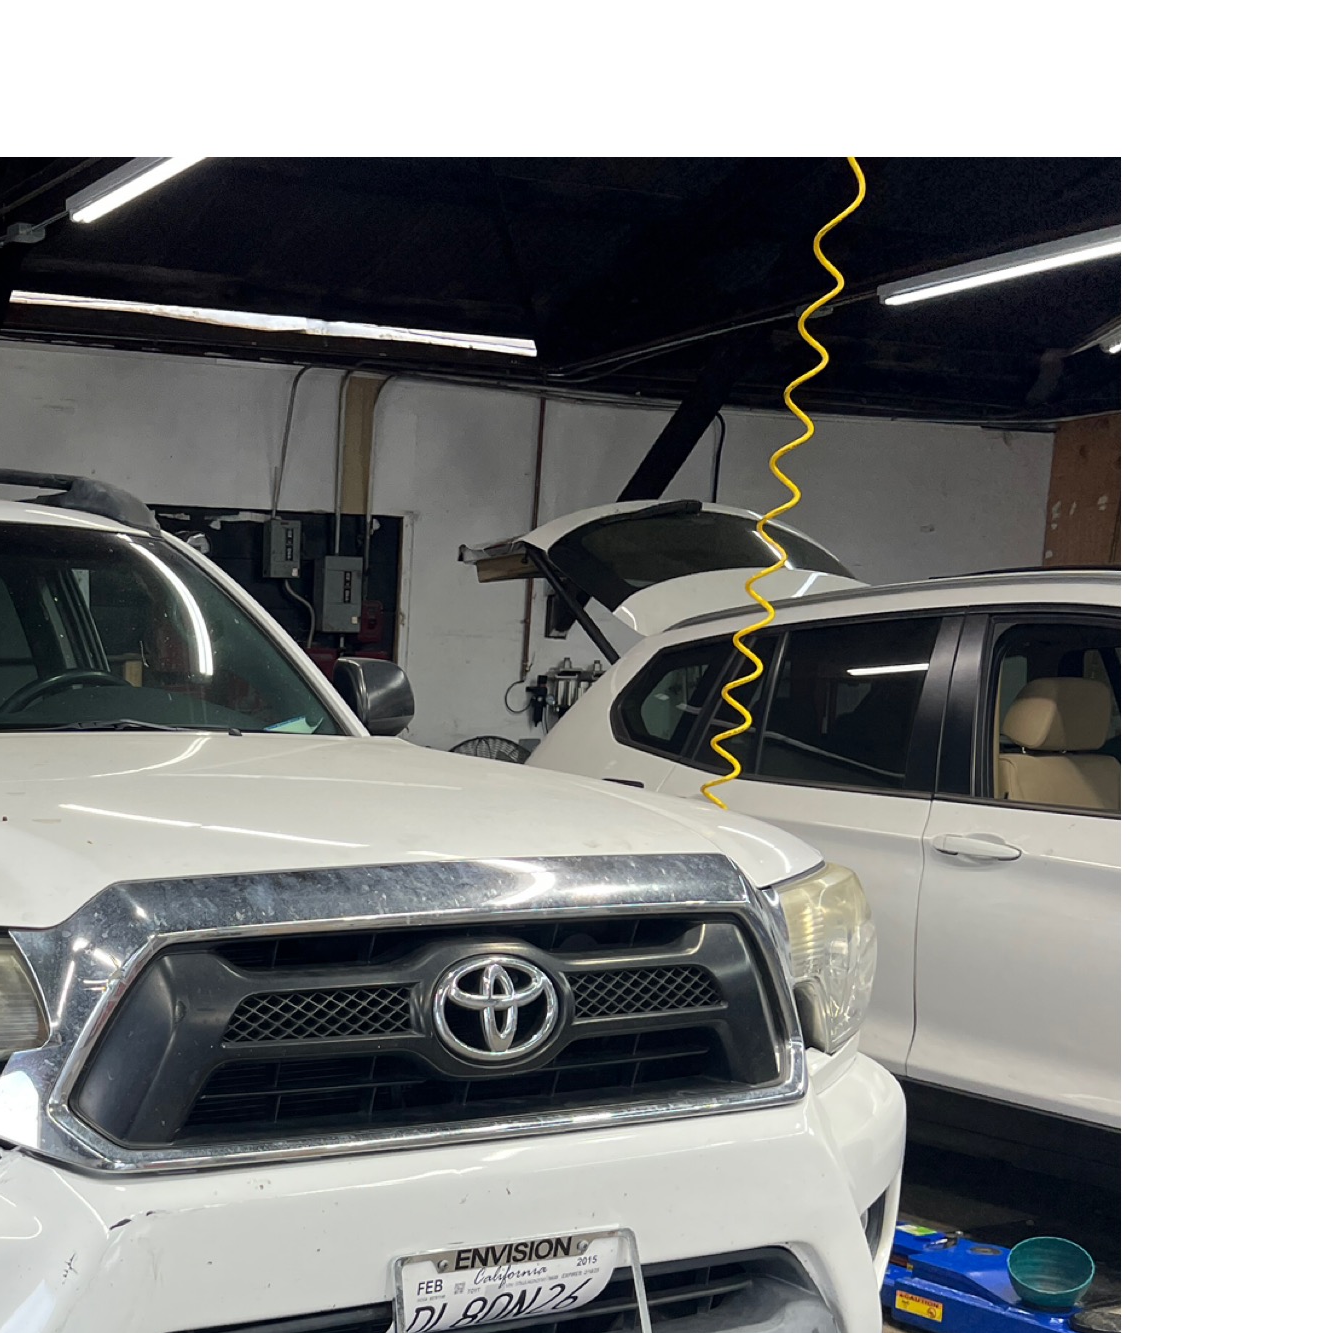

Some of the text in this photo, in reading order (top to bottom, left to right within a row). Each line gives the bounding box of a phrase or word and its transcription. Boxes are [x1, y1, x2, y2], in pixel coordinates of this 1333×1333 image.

[455, 1236, 572, 1271] ENVISION
[577, 1254, 598, 1267] 2015
[474, 1263, 548, 1289] California
[417, 1279, 443, 1296] FEB
